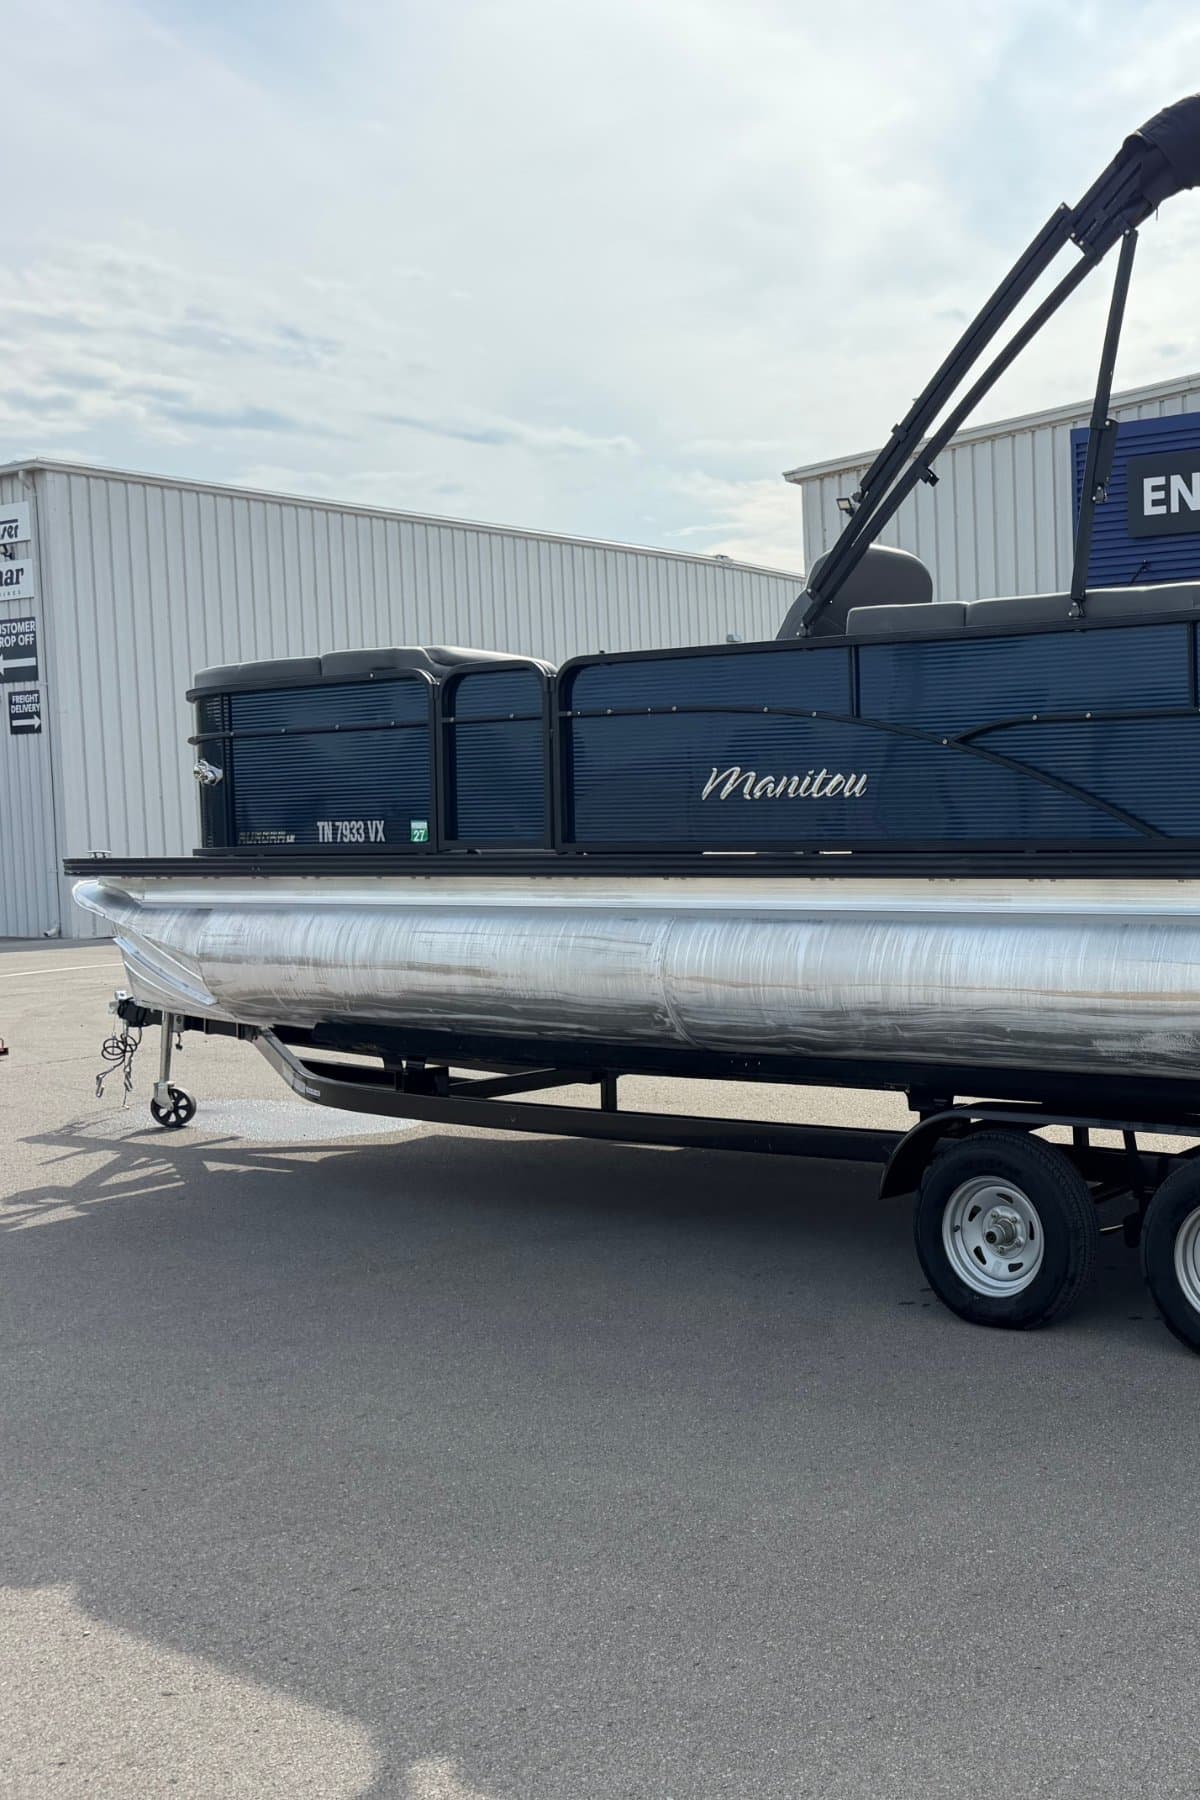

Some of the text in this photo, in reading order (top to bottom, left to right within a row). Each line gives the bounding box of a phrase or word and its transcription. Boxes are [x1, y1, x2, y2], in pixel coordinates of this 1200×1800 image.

[0, 621, 36, 636] STOMER
[18, 633, 34, 647] OFF
[12, 693, 38, 704] FREIGHT
[11, 703, 40, 714] DELIVERY
[702, 766, 868, 801] Manitou
[317, 821, 333, 843] TN
[336, 821, 365, 843] 7933
[367, 820, 386, 842] VX
[413, 829, 426, 842] 27
